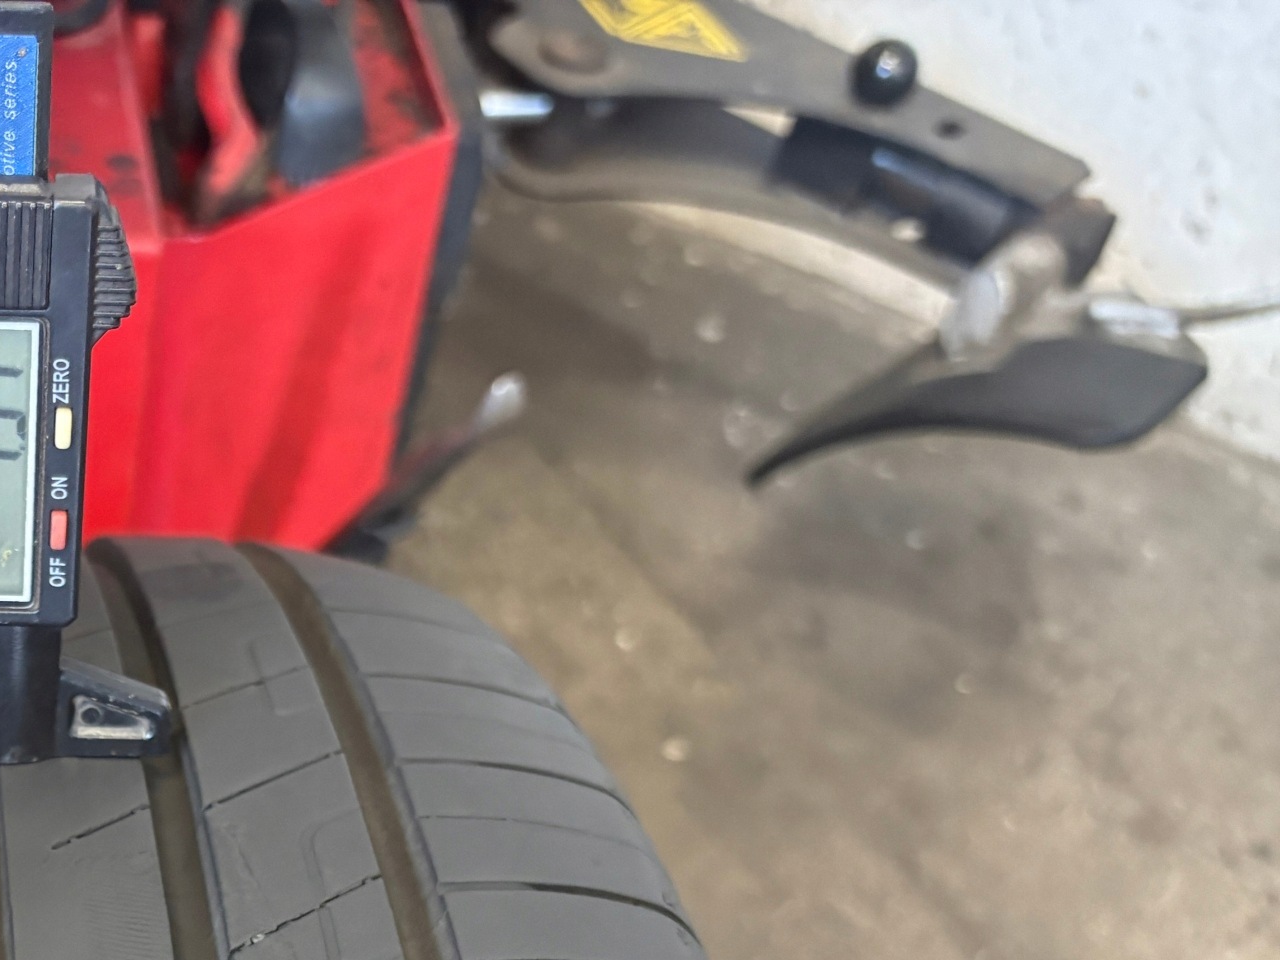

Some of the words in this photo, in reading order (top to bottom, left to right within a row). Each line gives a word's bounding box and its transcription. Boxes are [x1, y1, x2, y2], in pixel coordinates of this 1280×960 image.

[3, 59, 18, 120] series
[52, 358, 70, 404] ZERO
[50, 476, 68, 500] ON
[49, 557, 66, 588] OFF
